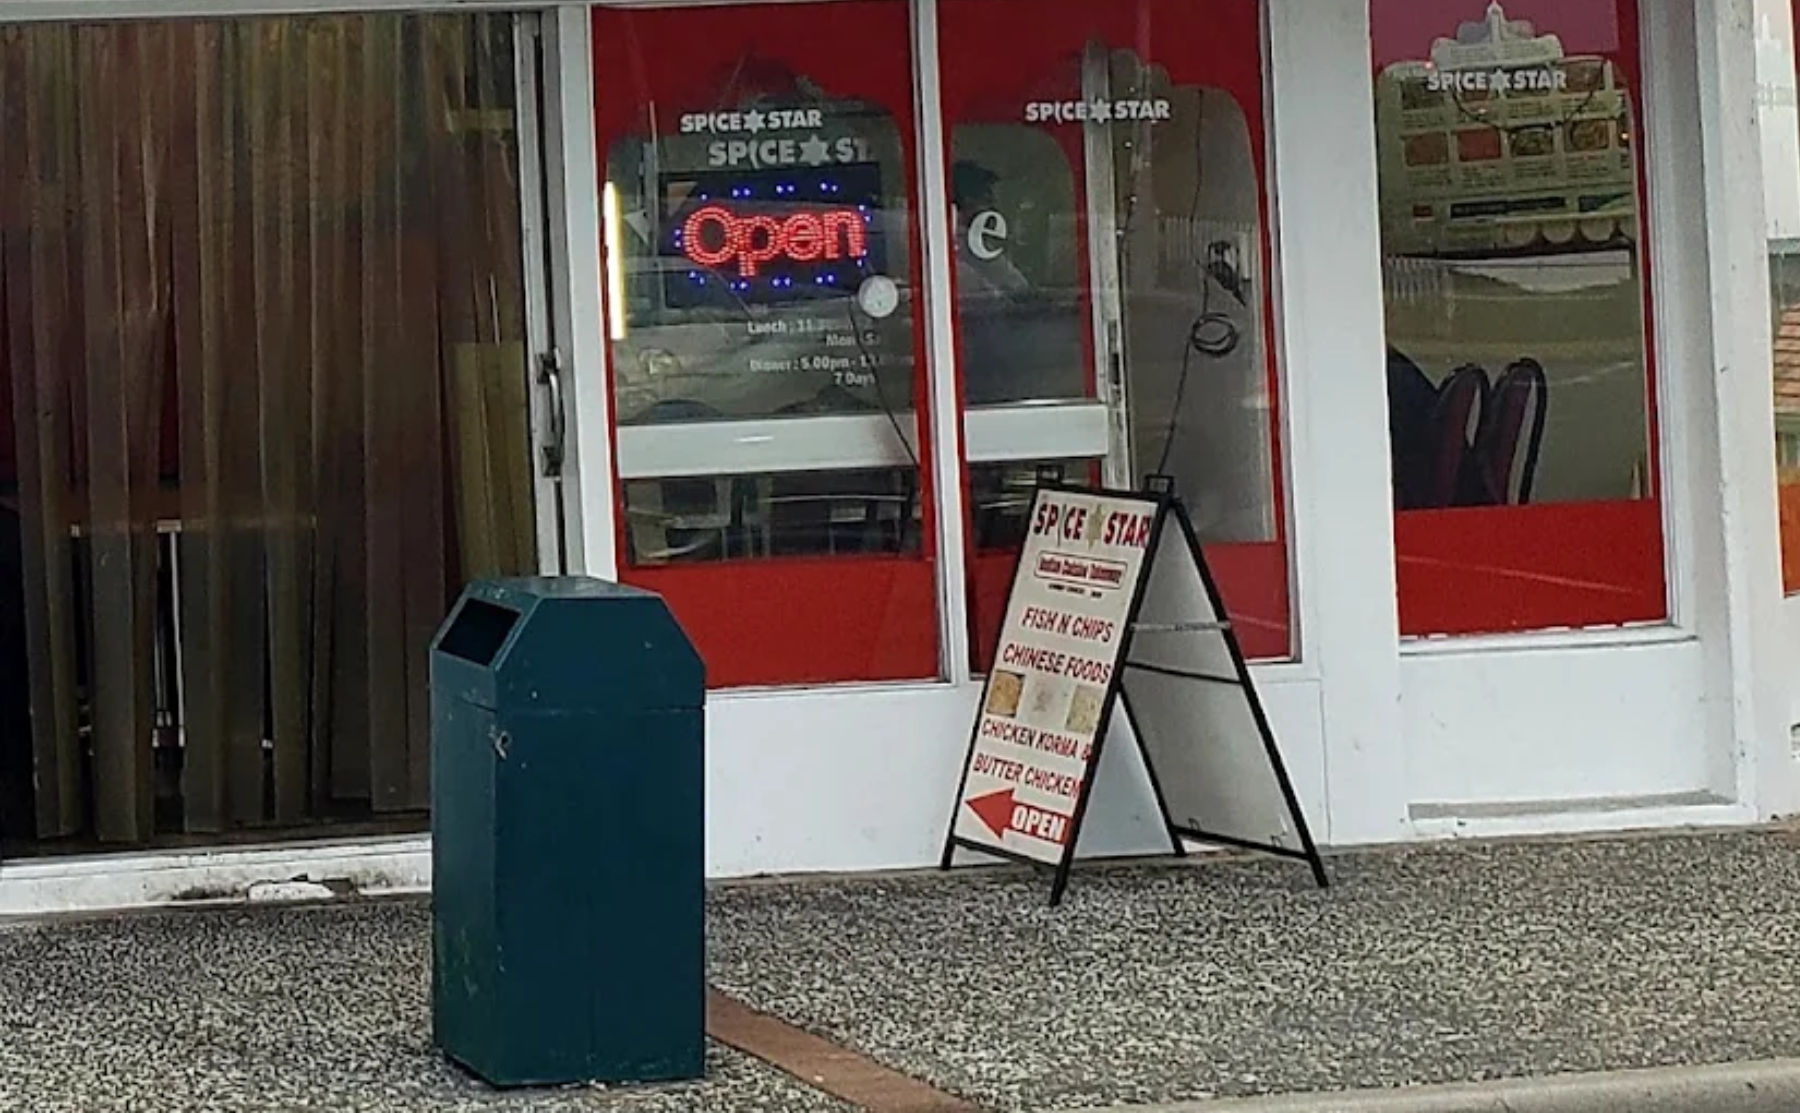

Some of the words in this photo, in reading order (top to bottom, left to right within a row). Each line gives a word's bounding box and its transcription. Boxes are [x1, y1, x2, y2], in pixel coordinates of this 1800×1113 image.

[1513, 68, 1567, 90] STAR
[767, 109, 823, 129] STAR
[1114, 99, 1171, 120] STAR
[683, 205, 867, 277] Open
[1103, 510, 1153, 548] STAR
[1021, 607, 1058, 632] FISH
[1072, 617, 1115, 643] CHIPS
[1002, 643, 1065, 675] CHINESE
[1064, 657, 1112, 685] FOODS
[980, 718, 1037, 747] CHICKEN
[1036, 730, 1080, 759] KORMA
[973, 753, 1025, 783] BUTTER
[1024, 767, 1083, 799] CHICKEN
[1011, 805, 1067, 842] OPEN
